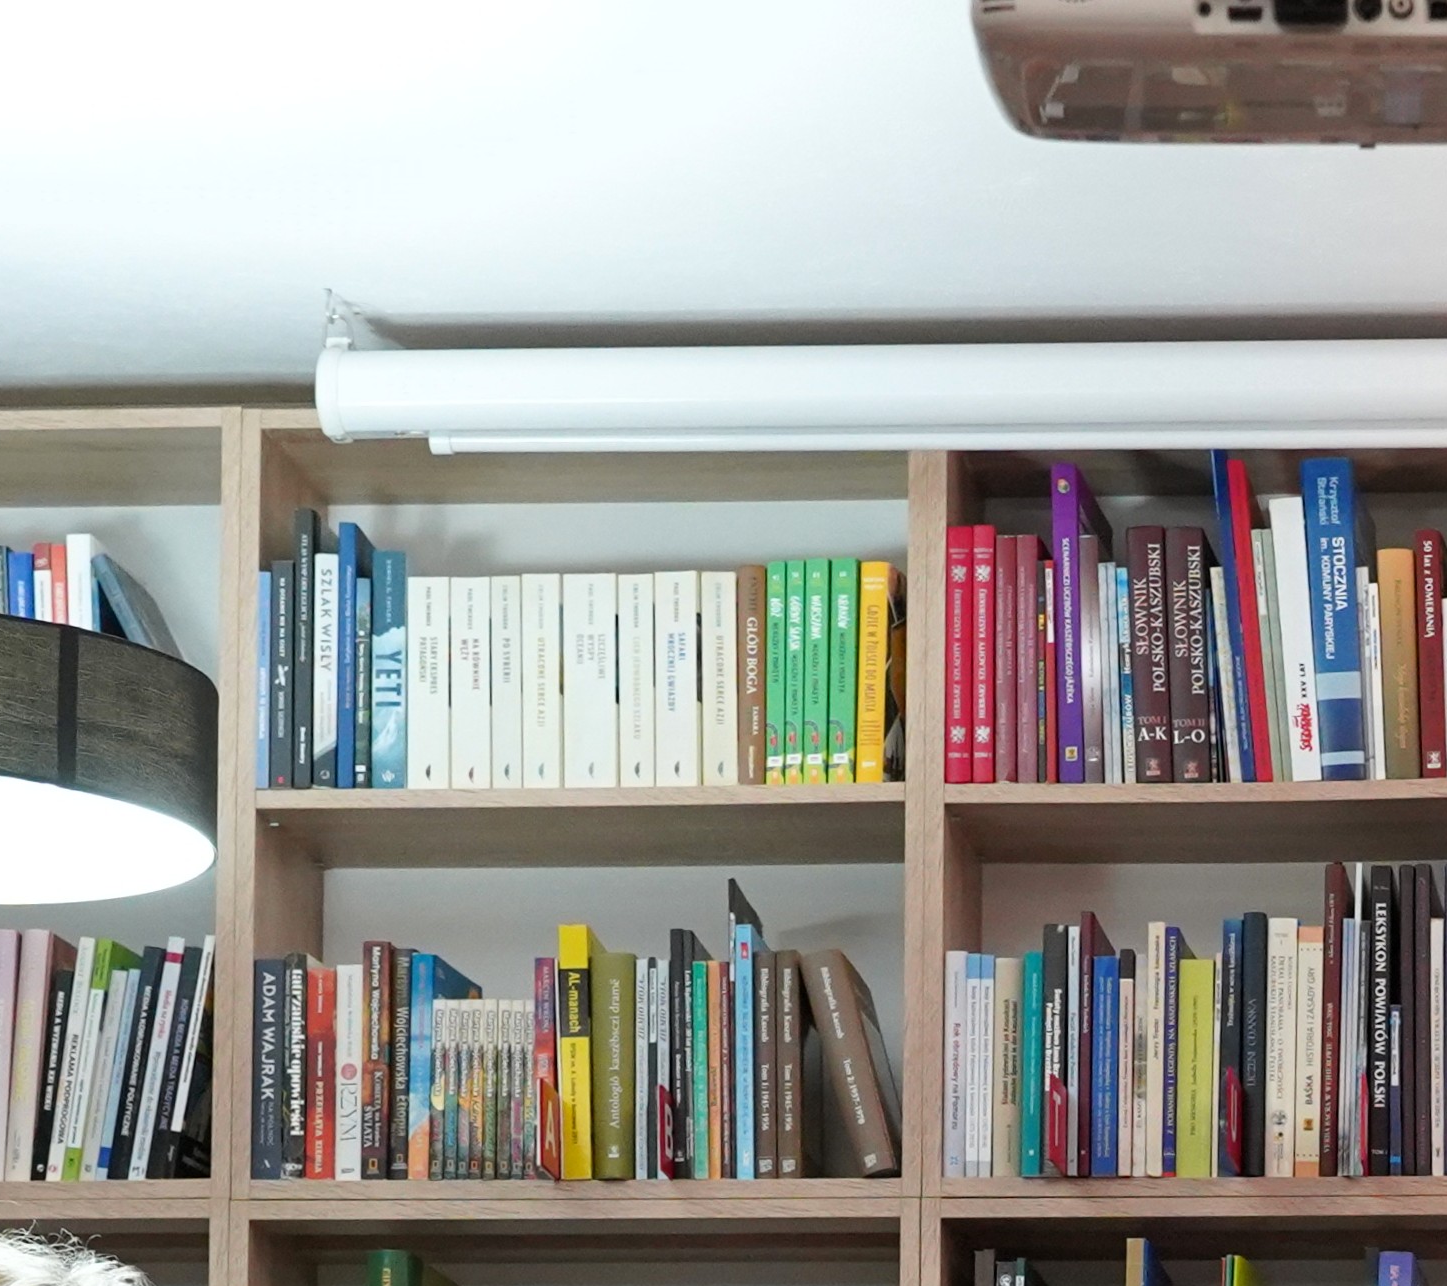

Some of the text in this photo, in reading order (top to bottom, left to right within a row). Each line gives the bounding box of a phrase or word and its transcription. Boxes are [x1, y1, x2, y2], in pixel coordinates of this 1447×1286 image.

[1317, 477, 1327, 526] Stefański
[1329, 476, 1340, 525] Krzysztof
[1321, 554, 1336, 661] KOMUNY PARYSKIEJ
[1332, 536, 1349, 612] STOCZNIA
[319, 568, 333, 672] SZLAK WISŁY
[745, 616, 759, 695] GŁÓD BOGA
[1132, 576, 1150, 656] SŁOWNIK
[1147, 543, 1166, 693] POLSKO-KASZUBSKI
[1172, 579, 1189, 658] SŁOWNIK
[1187, 545, 1205, 695] POLSKO-KASZUBSKI
[374, 650, 402, 708] YETI
[1137, 727, 1167, 742] A-K
[1173, 729, 1206, 745] L-O
[261, 971, 278, 1100] ADAM WAJRAK
[370, 945, 382, 1060] Martyna Wojciechowska
[567, 971, 582, 1034] AL-manach
[1373, 902, 1388, 1108] LEKSYKON POWIATÓW POLSKI
[395, 1006, 410, 1090] Wojciechowska
[339, 1082, 357, 1142] RZYM
[1304, 1074, 1314, 1106] BAŚKA
